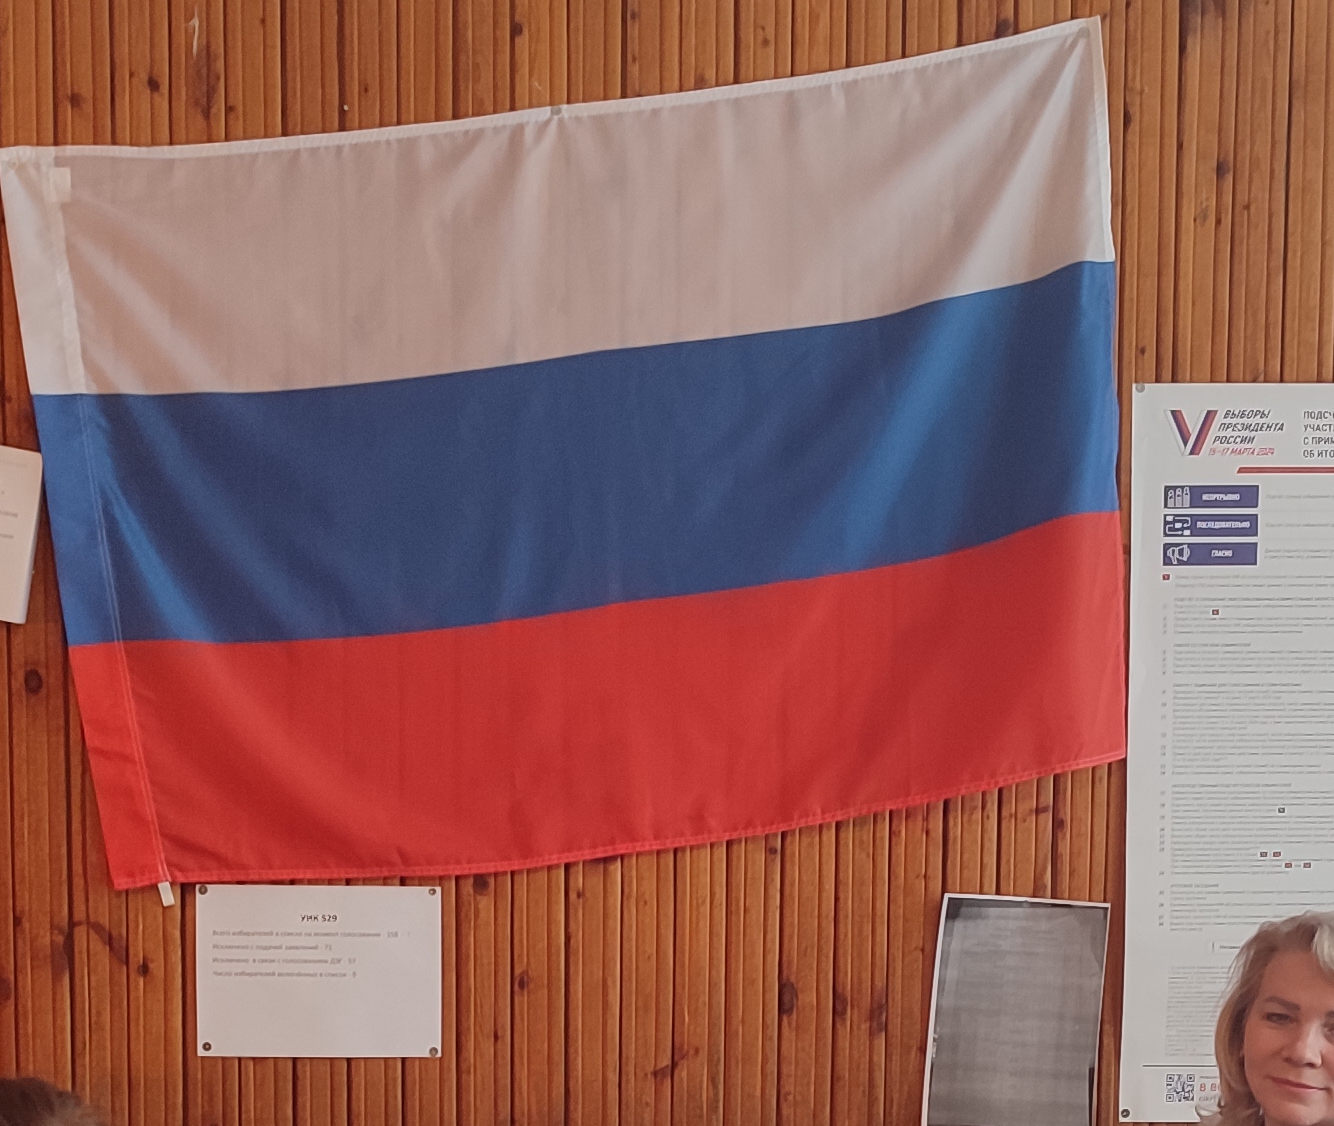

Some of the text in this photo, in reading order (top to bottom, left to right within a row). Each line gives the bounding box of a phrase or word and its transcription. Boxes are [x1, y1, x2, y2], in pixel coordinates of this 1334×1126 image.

[1223, 409, 1271, 419] ВЫБОРЫ
[1218, 422, 1285, 433] ПРЕЗИДЕНТА
[1212, 435, 1256, 445] РОССИИ
[1303, 437, 1309, 445] С
[1303, 449, 1315, 458] ОБ
[321, 914, 338, 922] 529
